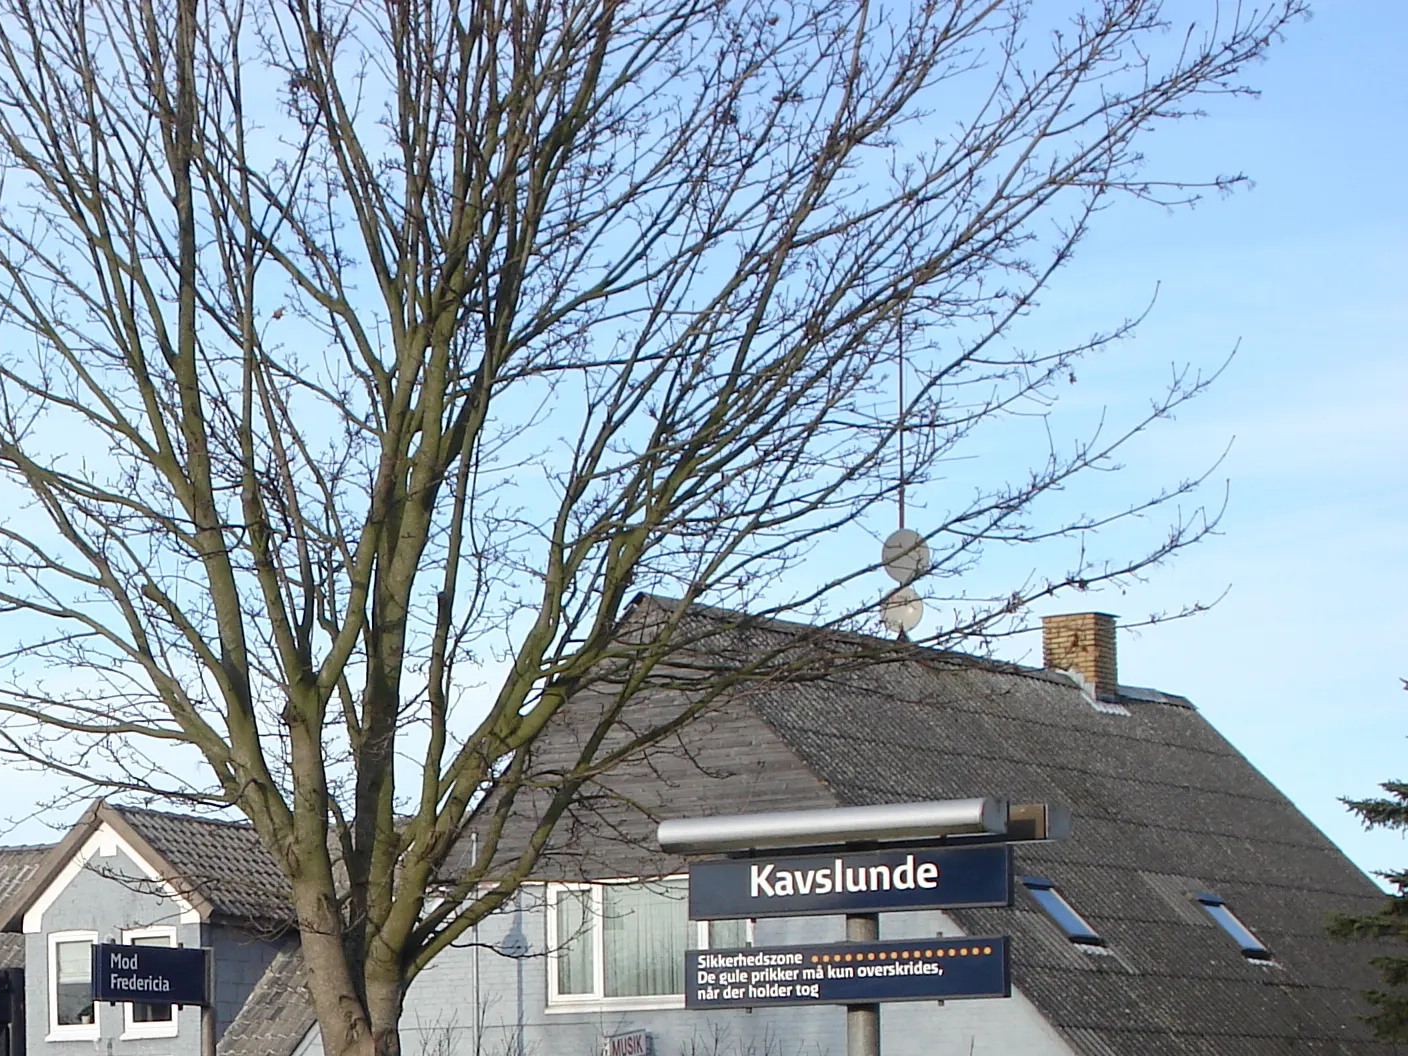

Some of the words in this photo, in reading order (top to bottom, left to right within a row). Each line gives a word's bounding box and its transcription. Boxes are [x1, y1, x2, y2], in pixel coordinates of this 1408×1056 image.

[750, 854, 939, 898] Kavslunde
[110, 952, 139, 970] Mod
[697, 951, 803, 969] Sikkerhedszone
[697, 970, 716, 985] De
[719, 968, 748, 985] gule
[751, 966, 799, 985] prikker
[802, 964, 824, 980] må
[827, 964, 853, 980] kun
[857, 960, 944, 979] overskrides,
[110, 973, 170, 992] Fredericia
[697, 985, 720, 1000] når
[722, 985, 746, 999] der
[748, 983, 793, 998] holder
[795, 983, 820, 998] tog
